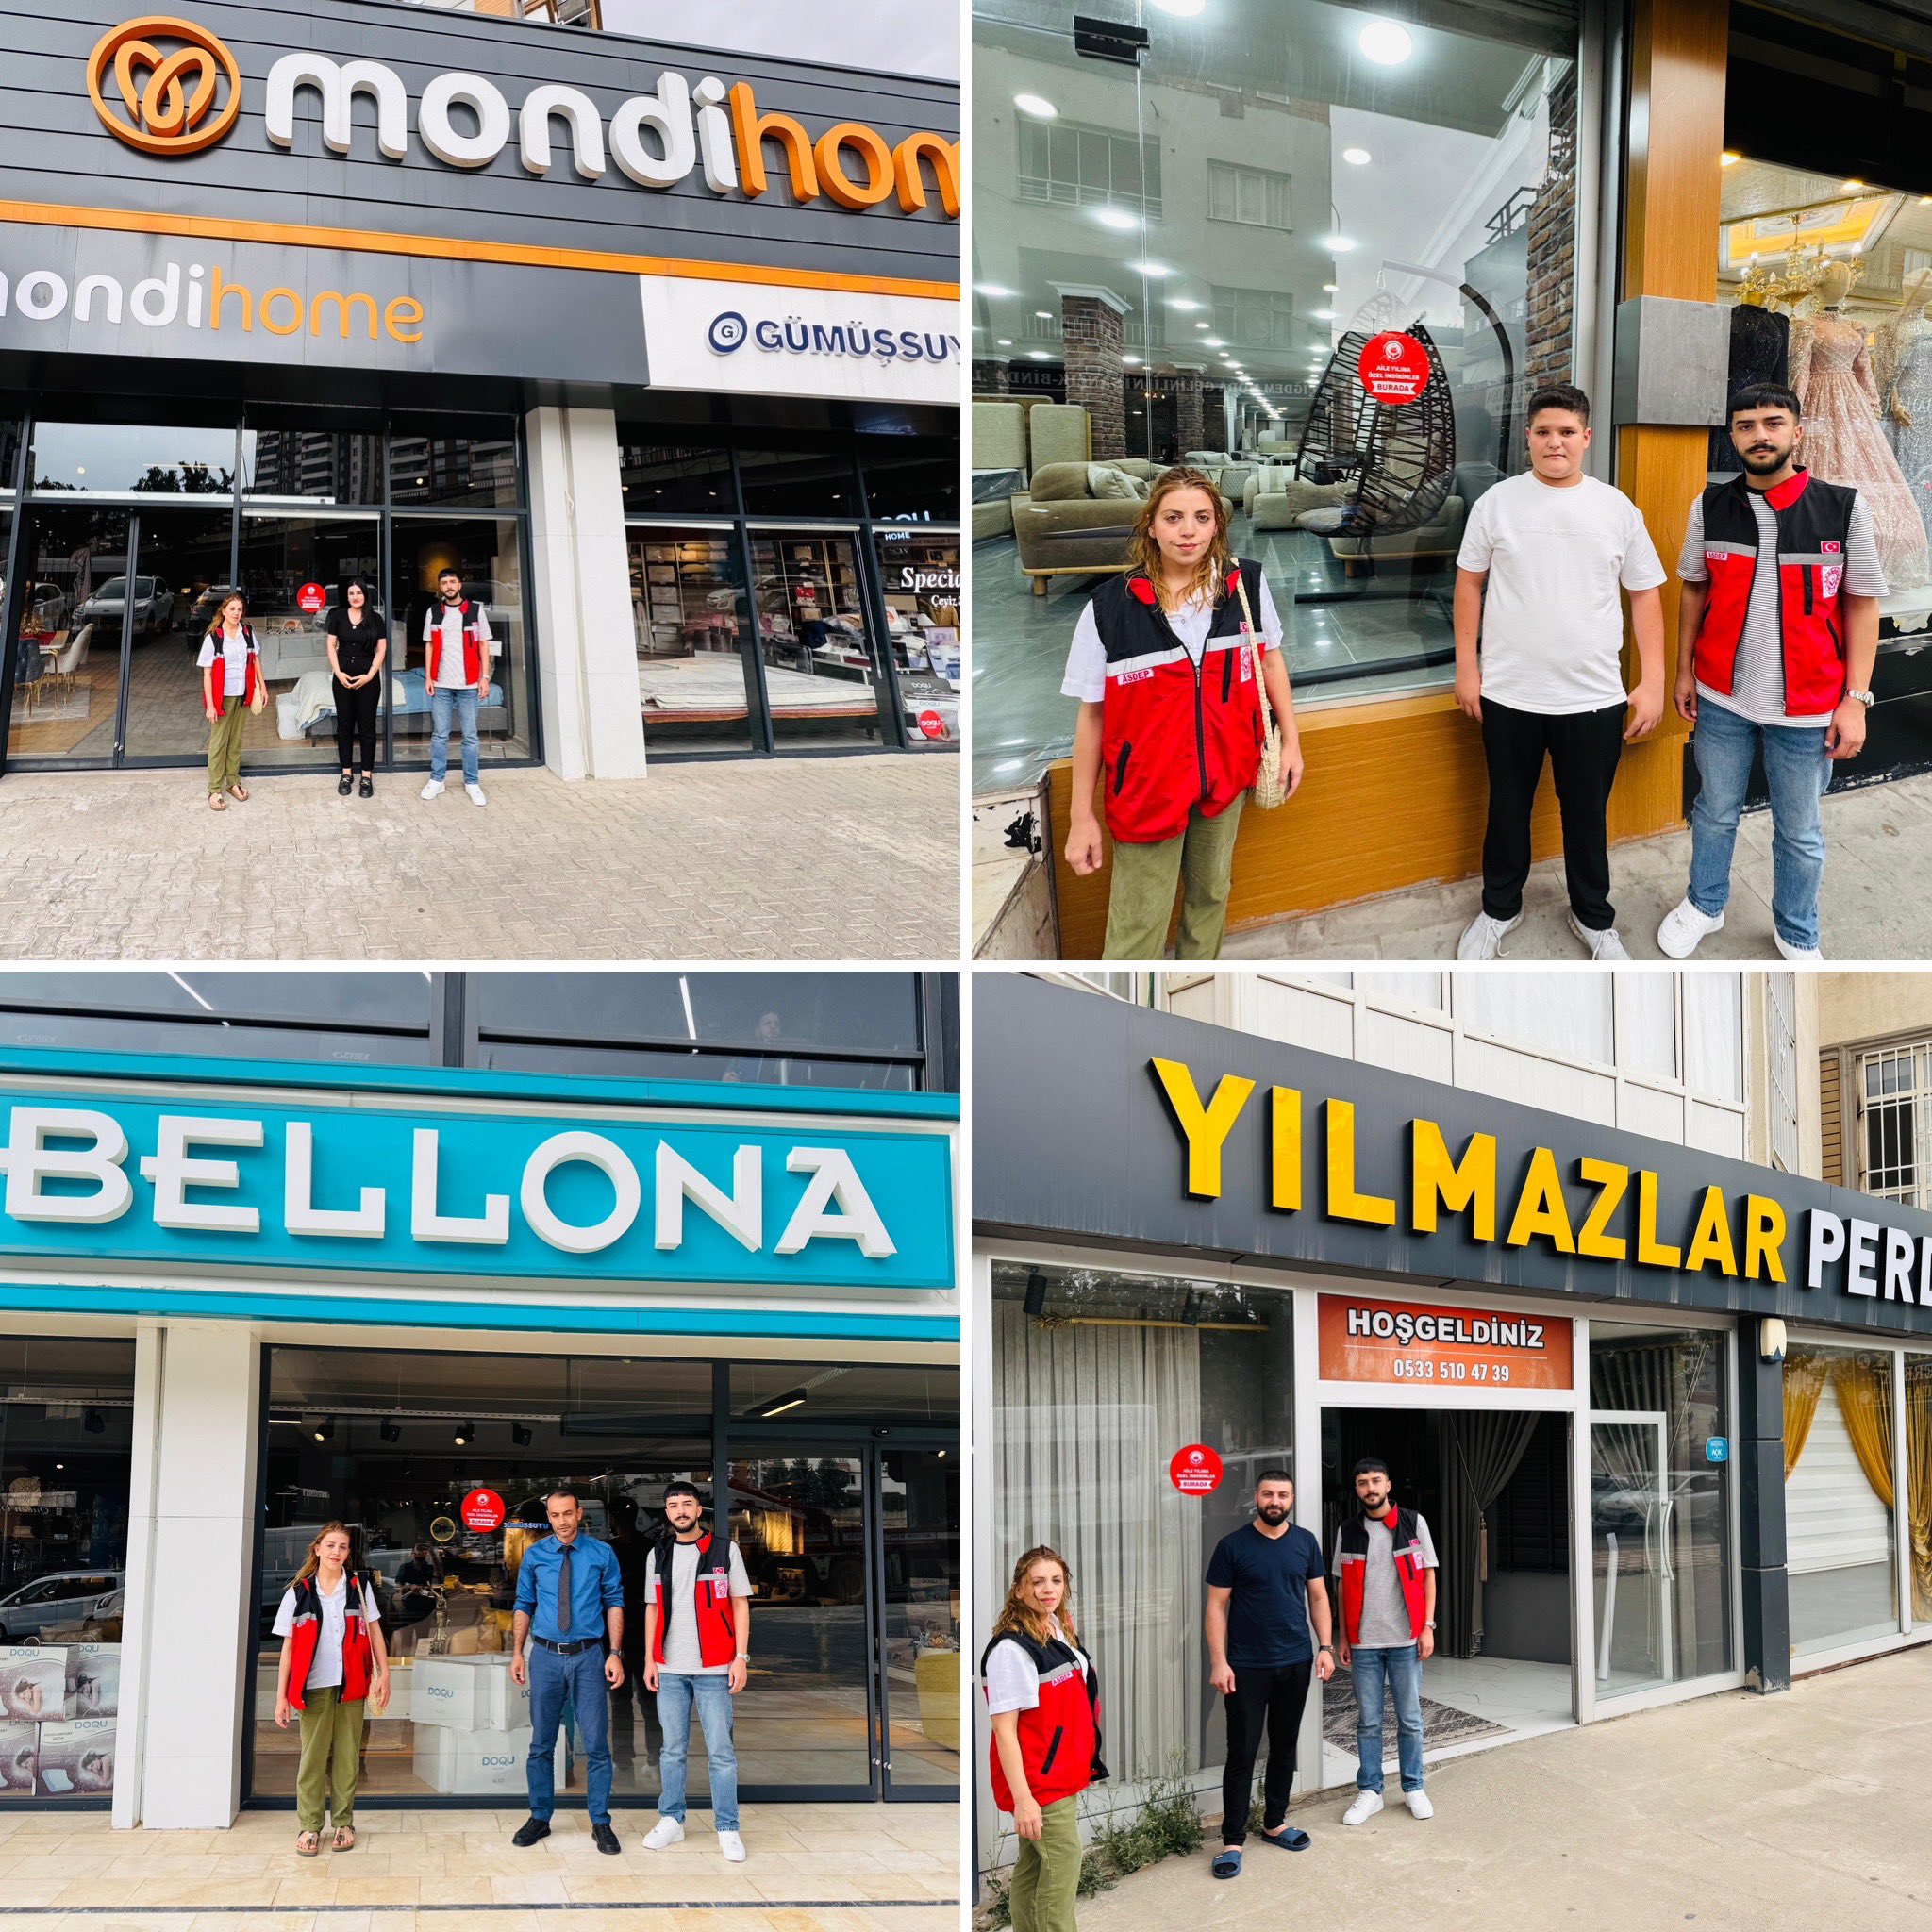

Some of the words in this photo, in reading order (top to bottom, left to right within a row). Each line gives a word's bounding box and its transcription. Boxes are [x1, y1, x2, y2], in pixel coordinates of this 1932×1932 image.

[0, 262, 425, 343] ondihome
[1376, 383, 1410, 391] BURADA
[884, 531, 911, 541] HOME
[930, 594, 958, 608] Çeyiz
[1122, 670, 1150, 683] ASDEP
[1150, 1055, 1788, 1285] YILMAZLAR
[0, 1105, 897, 1260] BELLONA
[1346, 1306, 1546, 1351] HOŞGELDİNİZ
[1393, 1358, 1435, 1380] 0533
[1440, 1360, 1466, 1381] 510
[1469, 1362, 1488, 1382] 47
[1491, 1363, 1510, 1383] 39
[9, 1648, 40, 1657] DOQU
[427, 1687, 454, 1698] DOQU
[75, 1720, 108, 1730] DOQU
[482, 1756, 515, 1766] DOQU
